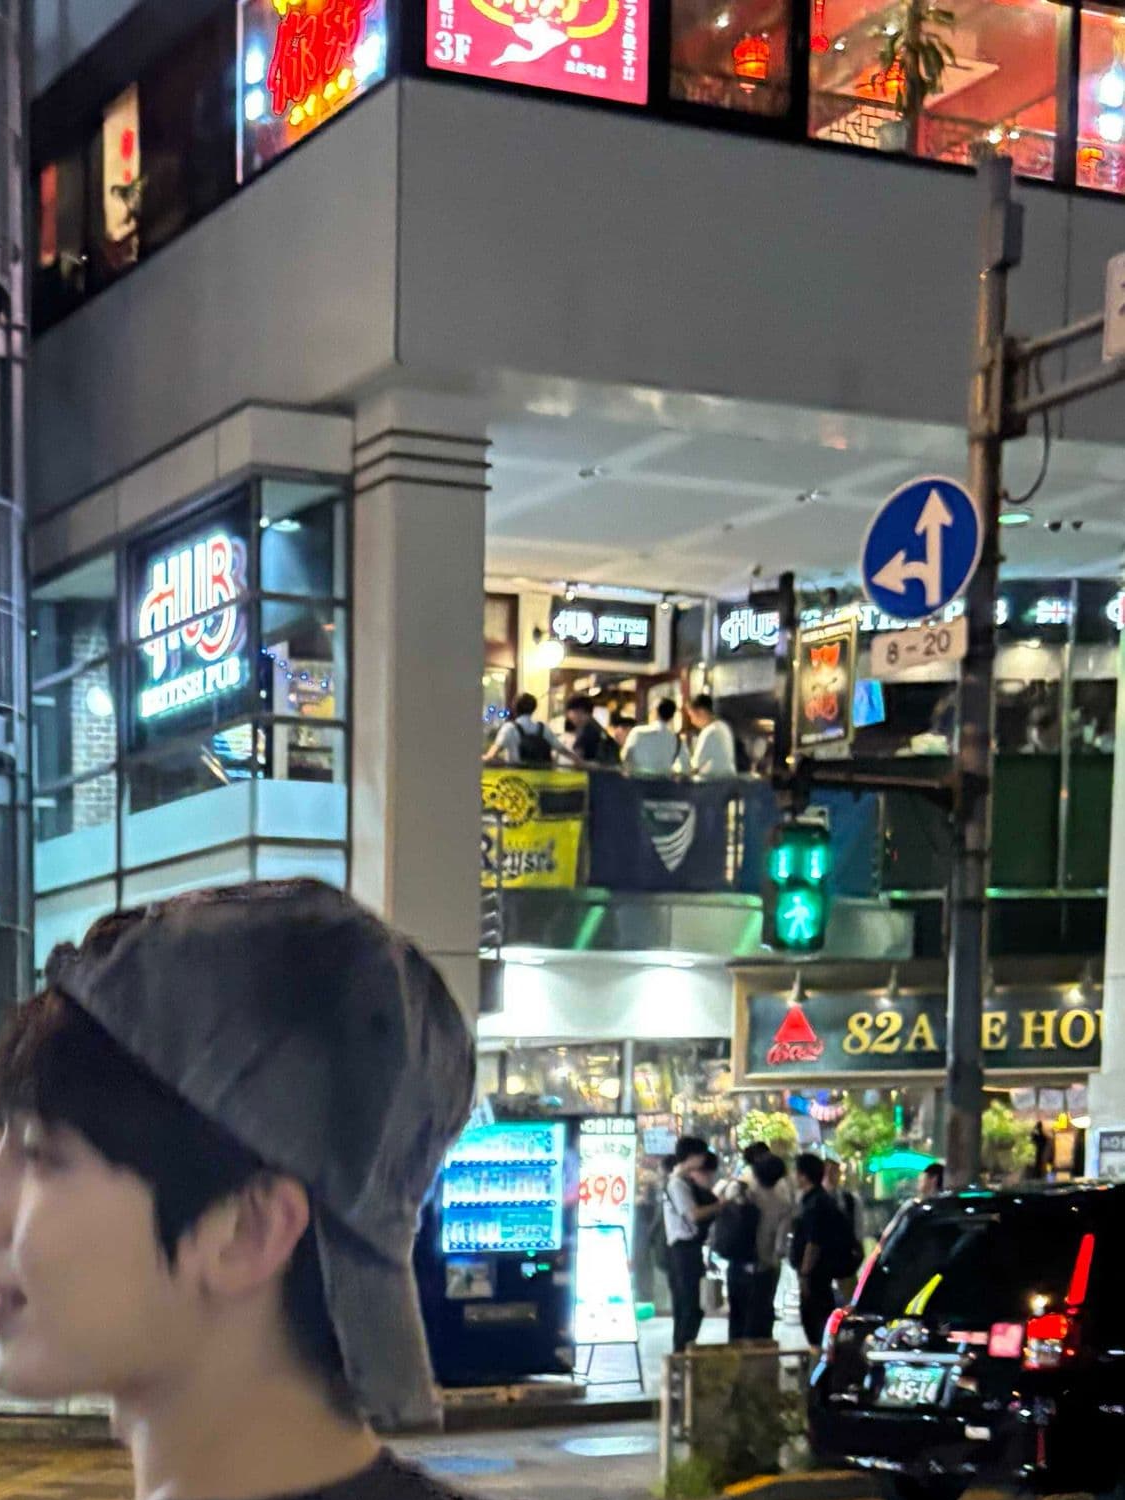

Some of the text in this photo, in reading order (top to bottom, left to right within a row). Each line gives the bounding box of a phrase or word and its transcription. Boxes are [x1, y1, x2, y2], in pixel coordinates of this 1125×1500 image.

[435, 31, 472, 64] 3F
[139, 535, 237, 680] HUB
[553, 610, 595, 645] HUB
[886, 628, 951, 666] 8-20
[205, 656, 241, 694] PUB
[842, 1008, 1104, 1055] 82 AE HO
[579, 1175, 626, 1207] 490
